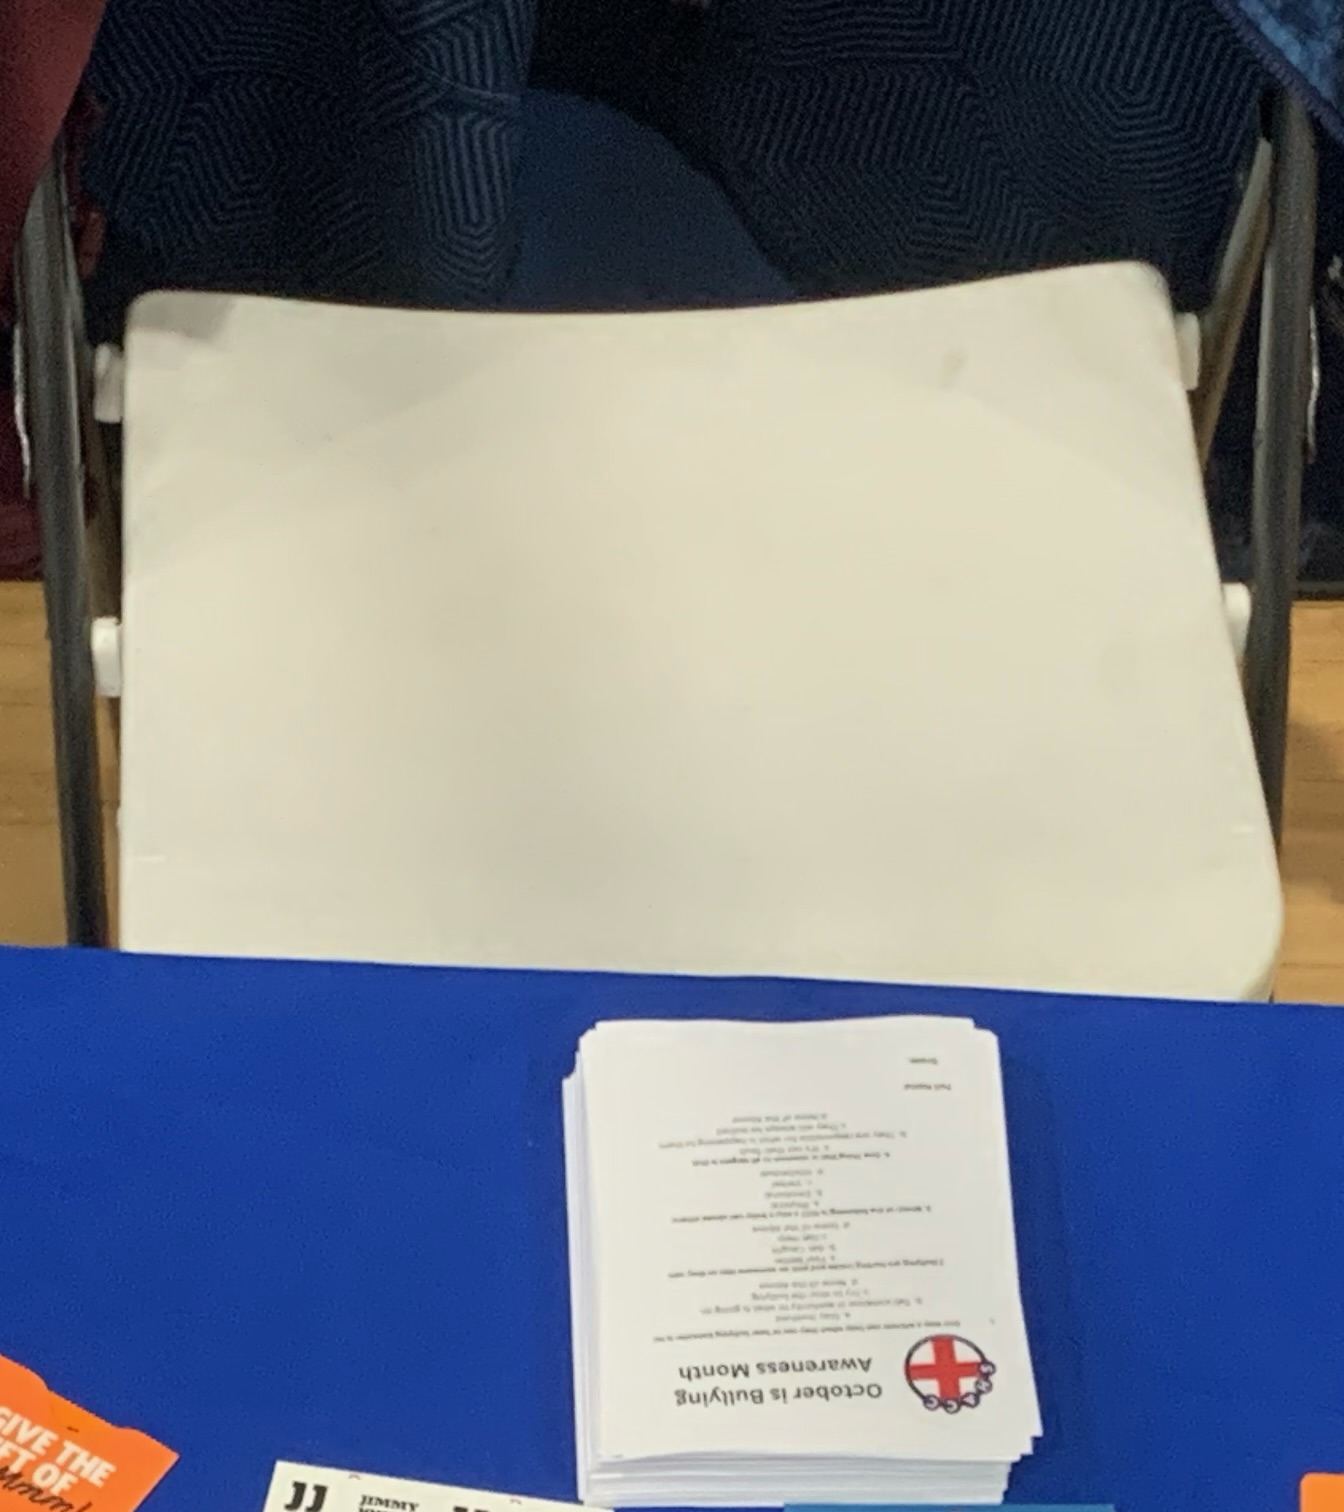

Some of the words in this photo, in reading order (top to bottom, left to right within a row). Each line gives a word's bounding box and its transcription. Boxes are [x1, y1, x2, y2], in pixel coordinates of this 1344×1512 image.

[677, 1362, 750, 1383] Month
[755, 1357, 873, 1375] Awareness
[673, 1385, 765, 1409] Bullying
[768, 1387, 788, 1405] is
[792, 1382, 883, 1403] October
[59, 1440, 116, 1488] THE
[31, 1462, 78, 1494] OF
[359, 1494, 419, 1512] JIMMY
